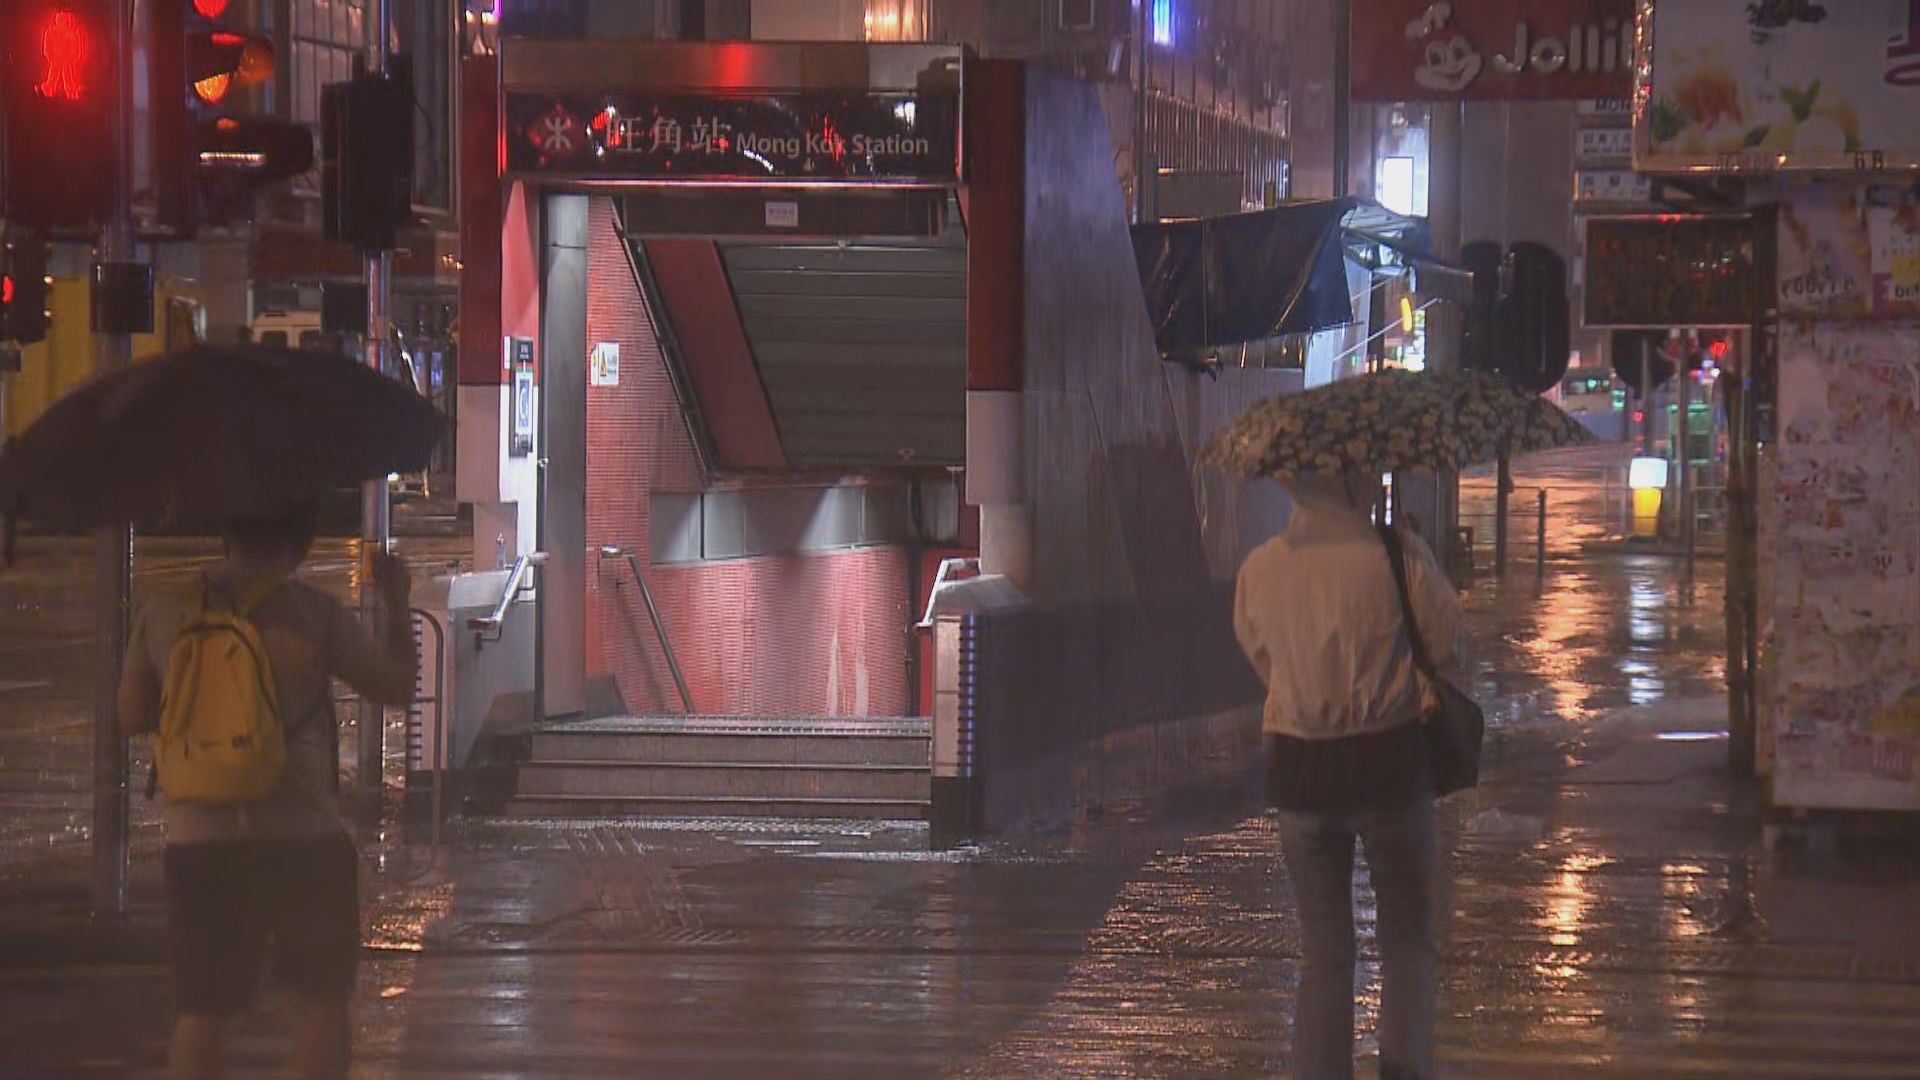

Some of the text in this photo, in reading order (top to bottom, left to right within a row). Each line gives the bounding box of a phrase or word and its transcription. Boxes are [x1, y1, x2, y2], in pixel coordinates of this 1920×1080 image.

[606, 115, 731, 154] 旺角站
[736, 132, 929, 157] Mong Kok Station
